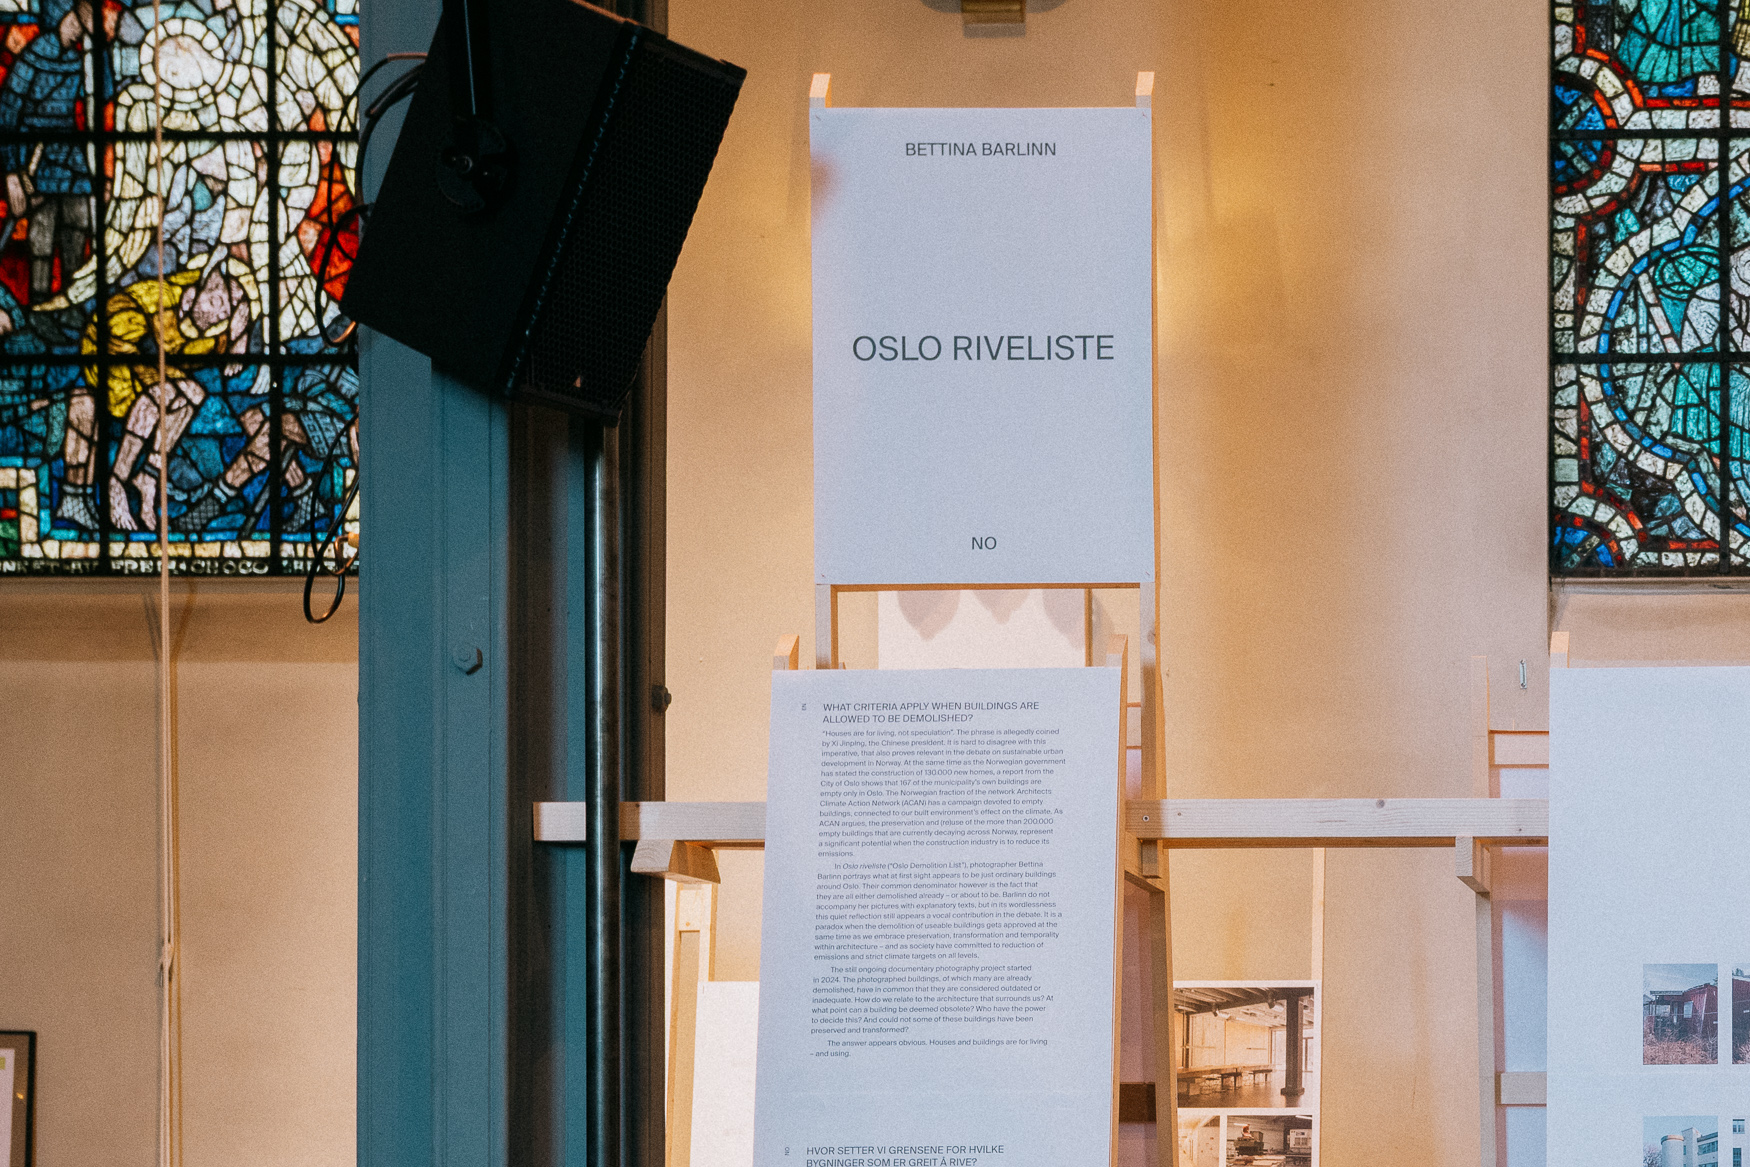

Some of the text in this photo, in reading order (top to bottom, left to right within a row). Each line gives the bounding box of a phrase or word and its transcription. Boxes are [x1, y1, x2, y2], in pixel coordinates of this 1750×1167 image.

[905, 142, 1057, 156] BETTINA BARLINN
[852, 334, 1115, 361] OSLO RIVELISTE
[971, 536, 997, 551] NO
[823, 702, 1039, 712] WHAT CRITERIA APPLY WHEN BUILDINGS ARE
[823, 714, 973, 724] ALLOWED TO BE DEMOLISHED?
[840, 739, 867, 749] Jinping,
[868, 739, 880, 747] the
[881, 739, 909, 747] Chinese
[910, 739, 946, 748] president.
[960, 738, 977, 746] hard
[986, 738, 1017, 747] disagree
[858, 965, 887, 975] ongoing
[888, 965, 934, 974] documentary
[935, 965, 979, 974] photography
[980, 964, 1005, 974] project
[1007, 964, 1032, 972] started
[812, 976, 820, 984] in
[821, 976, 841, 984] 2024.
[843, 976, 856, 984] The
[857, 976, 906, 985] photographed
[907, 975, 941, 985] buildings,
[942, 975, 950, 983] of
[973, 976, 992, 984] many
[1006, 974, 1032, 984] already
[828, 1040, 840, 1048] The
[868, 1041, 897, 1049] appears
[898, 1039, 928, 1047] obvious.
[972, 1038, 1004, 1048] buildings
[1018, 1038, 1028, 1046] for
[1029, 1038, 1048, 1047] living
[815, 1050, 829, 1058] and
[830, 1050, 851, 1059] using.
[806, 1146, 1004, 1156] HVOR SETTER VI GRENSENE FOR HVILKE
[806, 1159, 977, 1167] BYGNINGER SOM ER GREIT Å RIVE?
